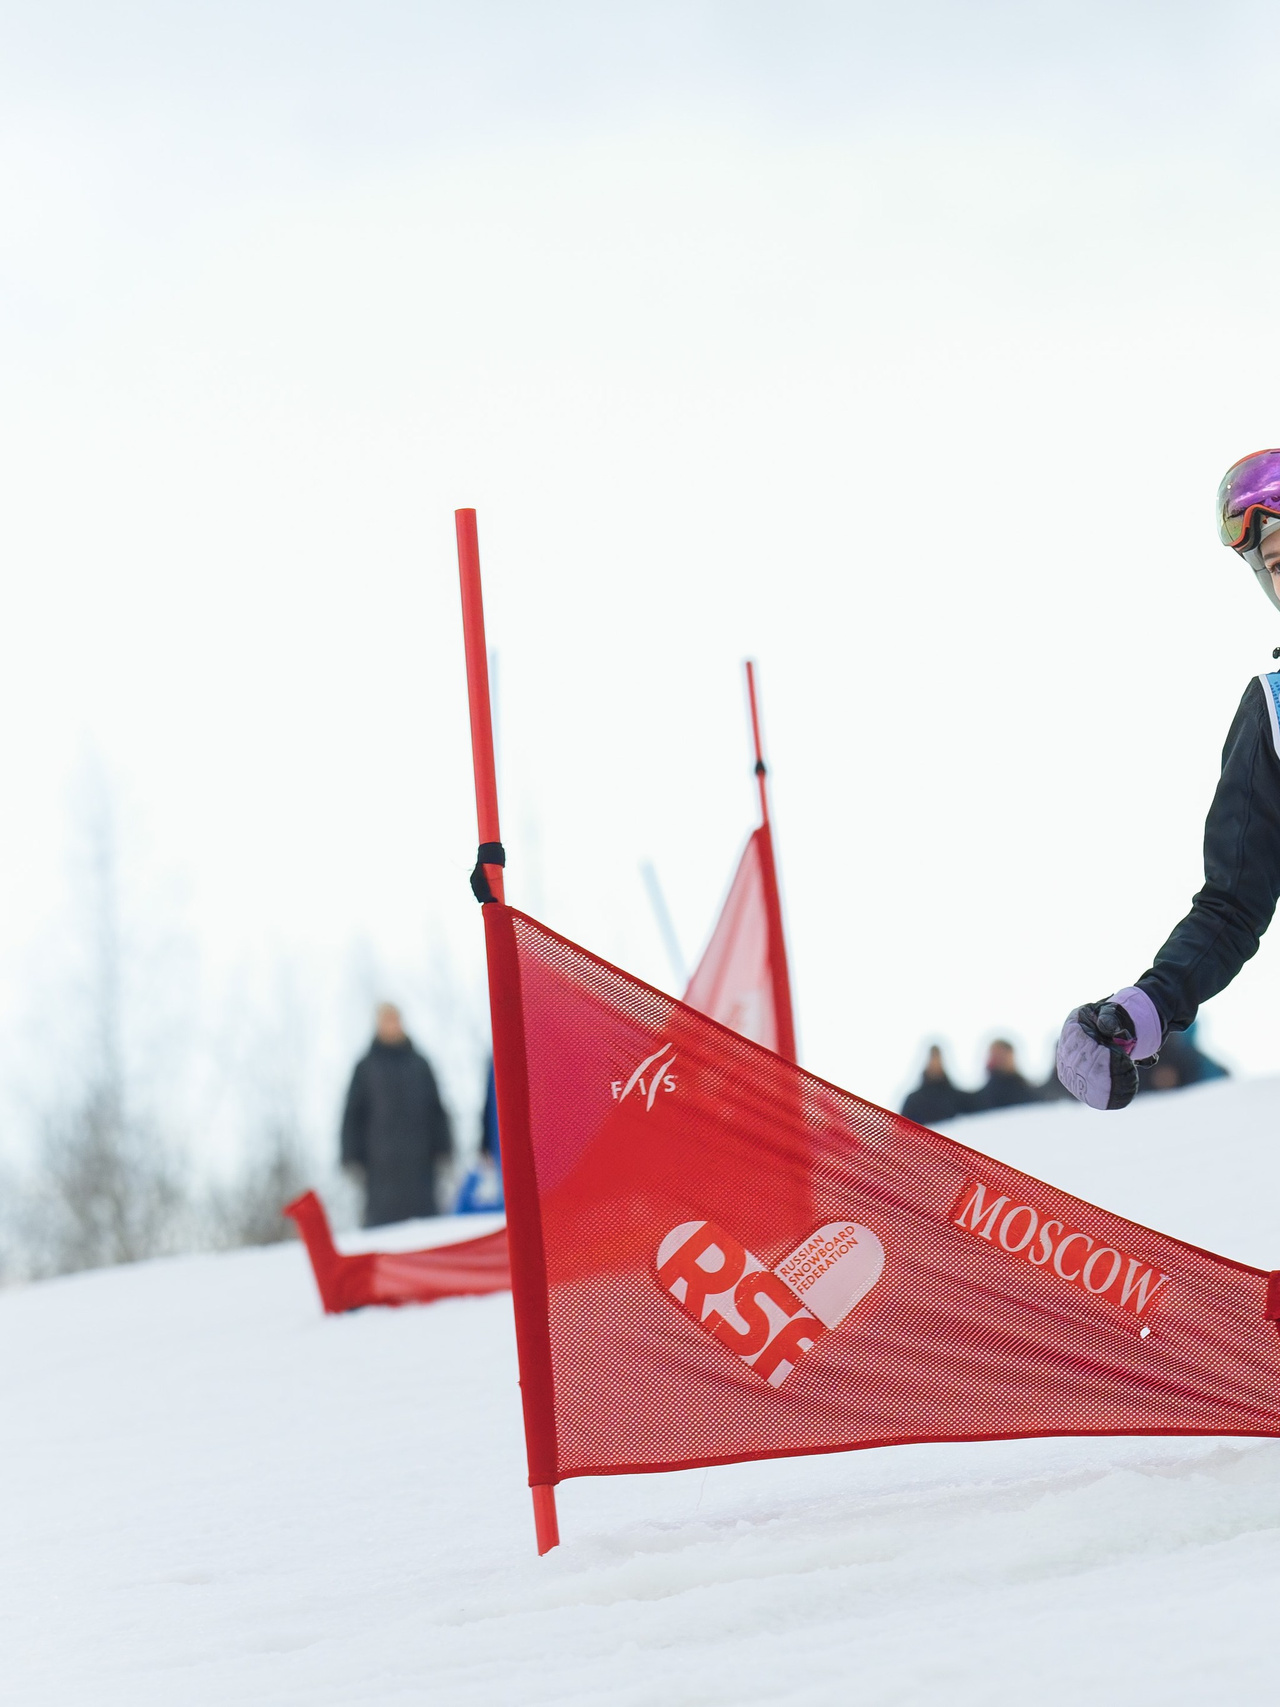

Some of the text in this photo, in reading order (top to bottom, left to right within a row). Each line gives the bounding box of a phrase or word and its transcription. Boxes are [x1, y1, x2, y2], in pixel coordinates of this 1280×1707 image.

[780, 1235, 825, 1277] RUSSIAN
[788, 1226, 855, 1286] SNOWBOARD
[796, 1237, 859, 1295] FEDERATION
[955, 1182, 1171, 1314] MOSCOW
